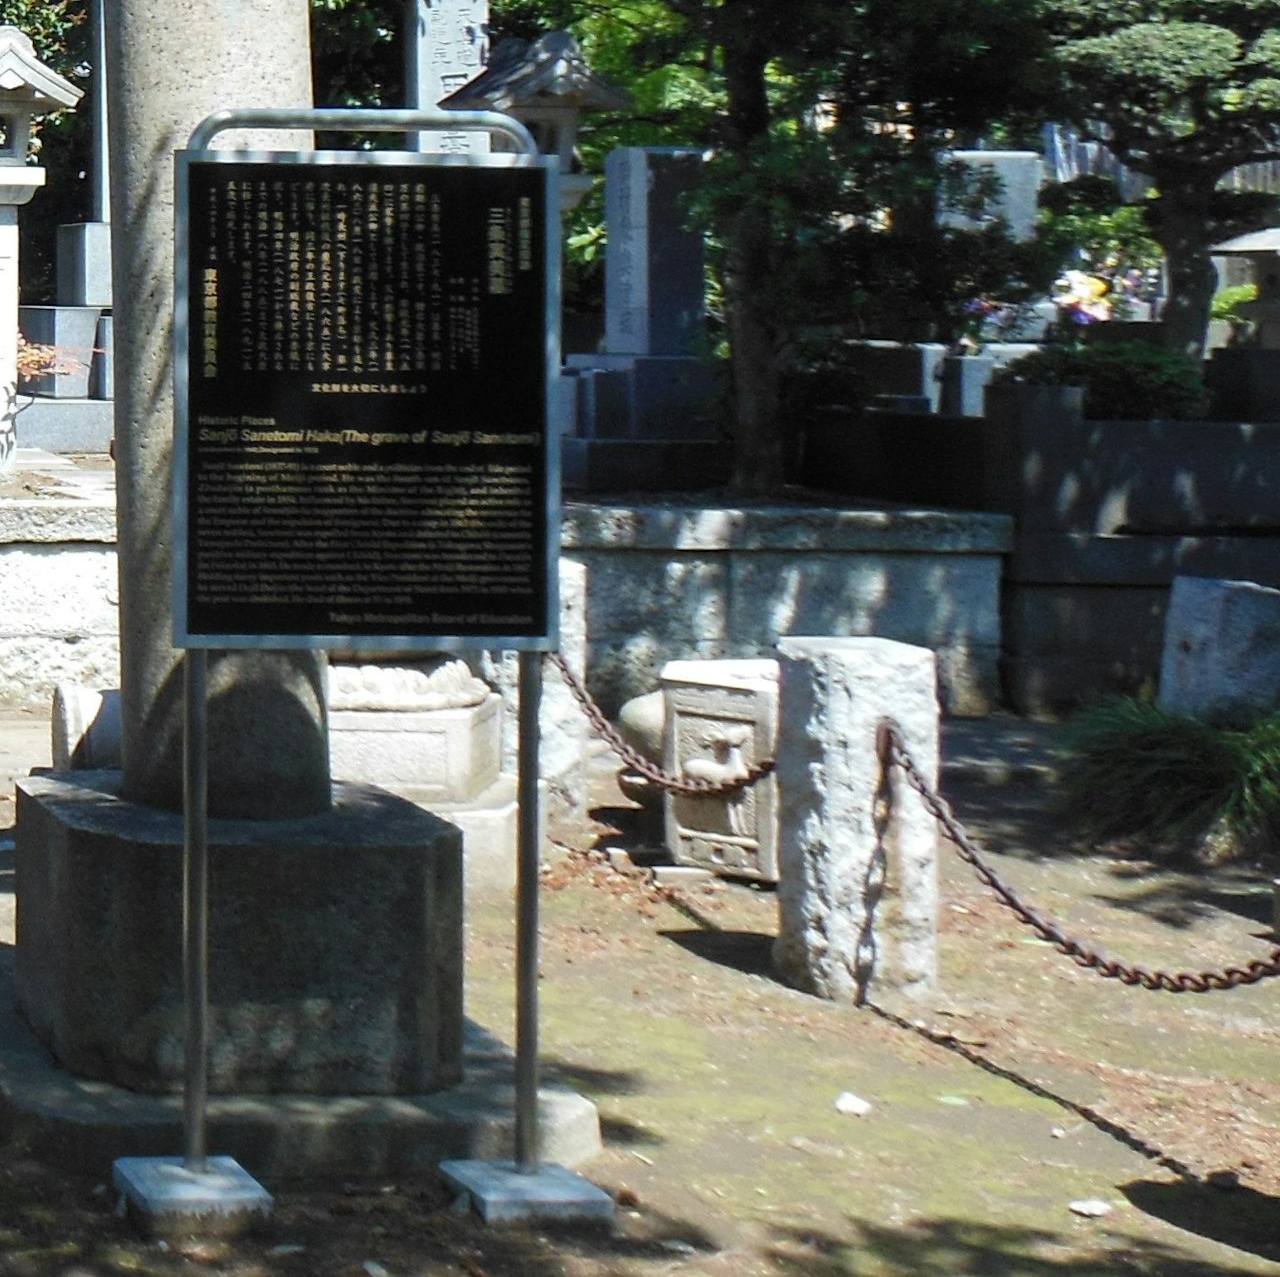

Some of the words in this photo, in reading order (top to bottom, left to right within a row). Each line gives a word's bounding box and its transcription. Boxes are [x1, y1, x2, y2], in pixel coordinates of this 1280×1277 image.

[240, 416, 276, 426] Places
[240, 429, 304, 442] Sanetomi
[371, 432, 409, 446] grave
[411, 430, 428, 444] of
